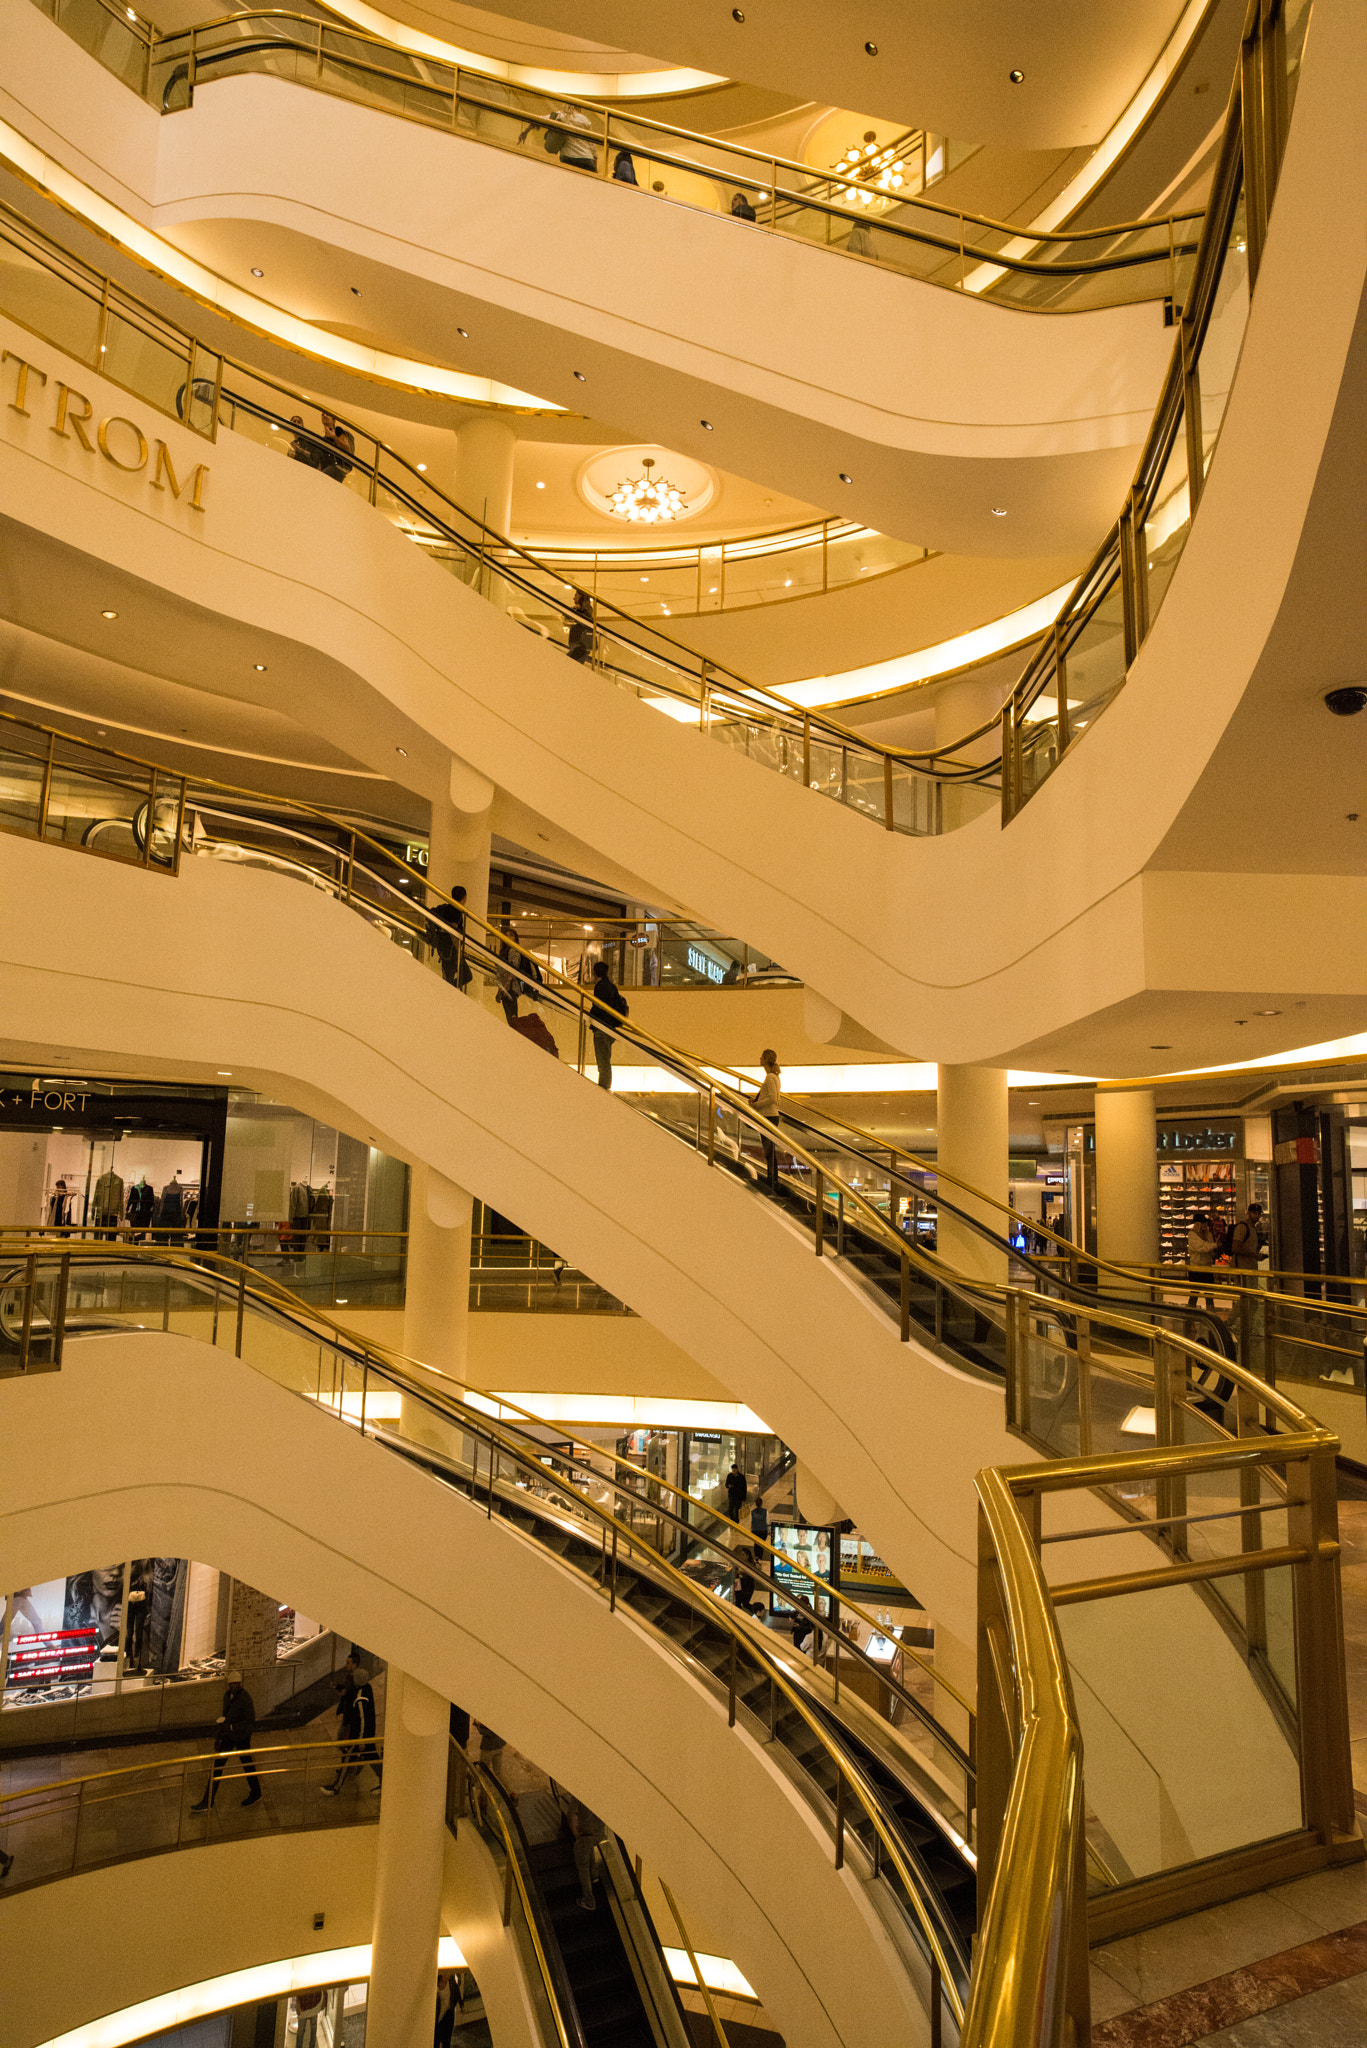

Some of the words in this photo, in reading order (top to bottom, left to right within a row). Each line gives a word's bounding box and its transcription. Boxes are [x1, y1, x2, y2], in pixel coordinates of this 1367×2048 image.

[2, 349, 210, 512] TROM
[31, 1090, 91, 1111] FORT
[1172, 1129, 1236, 1151] Locker
